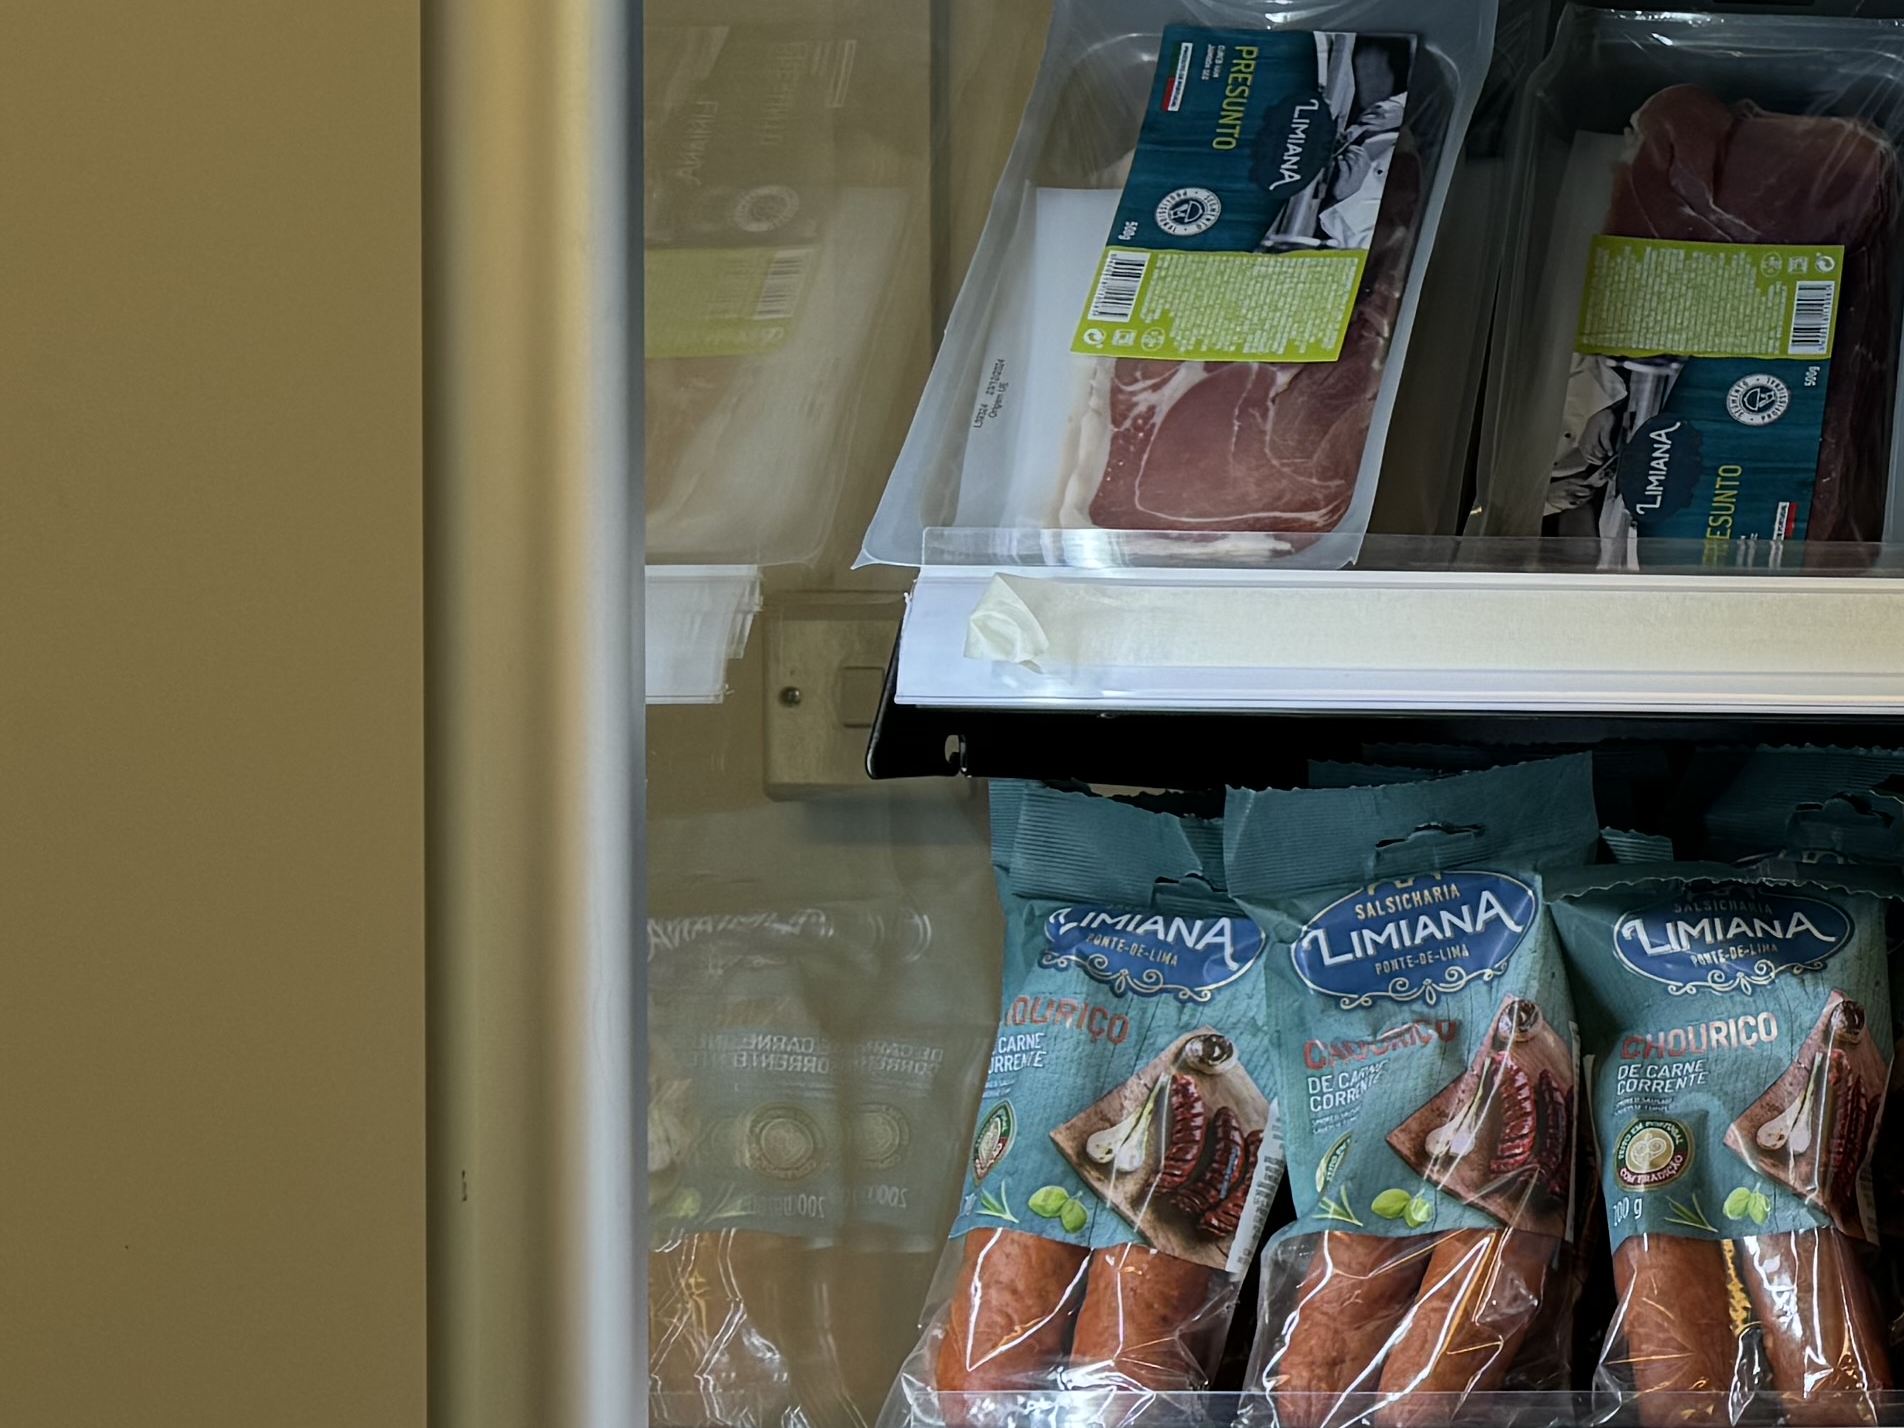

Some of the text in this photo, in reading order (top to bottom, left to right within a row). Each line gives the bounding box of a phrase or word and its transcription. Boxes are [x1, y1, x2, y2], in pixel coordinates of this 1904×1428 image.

[1213, 46, 1259, 151] PRESUNTO
[1269, 98, 1319, 191] LIMIANA
[1637, 421, 1682, 515] LIMIANA
[1353, 884, 1461, 920] SALSICHARIA
[1049, 909, 1240, 972] LIMIANA
[1301, 890, 1523, 967] LIMIANA
[1622, 912, 1836, 956] LIMIANA
[1086, 934, 1179, 967] PONTE-DE-LIMA
[1374, 944, 1470, 975] PONTE-DE-LIMA
[1690, 941, 1778, 966] PONTE-DE-LIMA
[1004, 994, 1131, 1046] OURIÇO
[1307, 1076, 1334, 1095] DE
[1617, 1059, 1707, 1081] DE CARNE
[1617, 1071, 1709, 1096] CORRENTE
